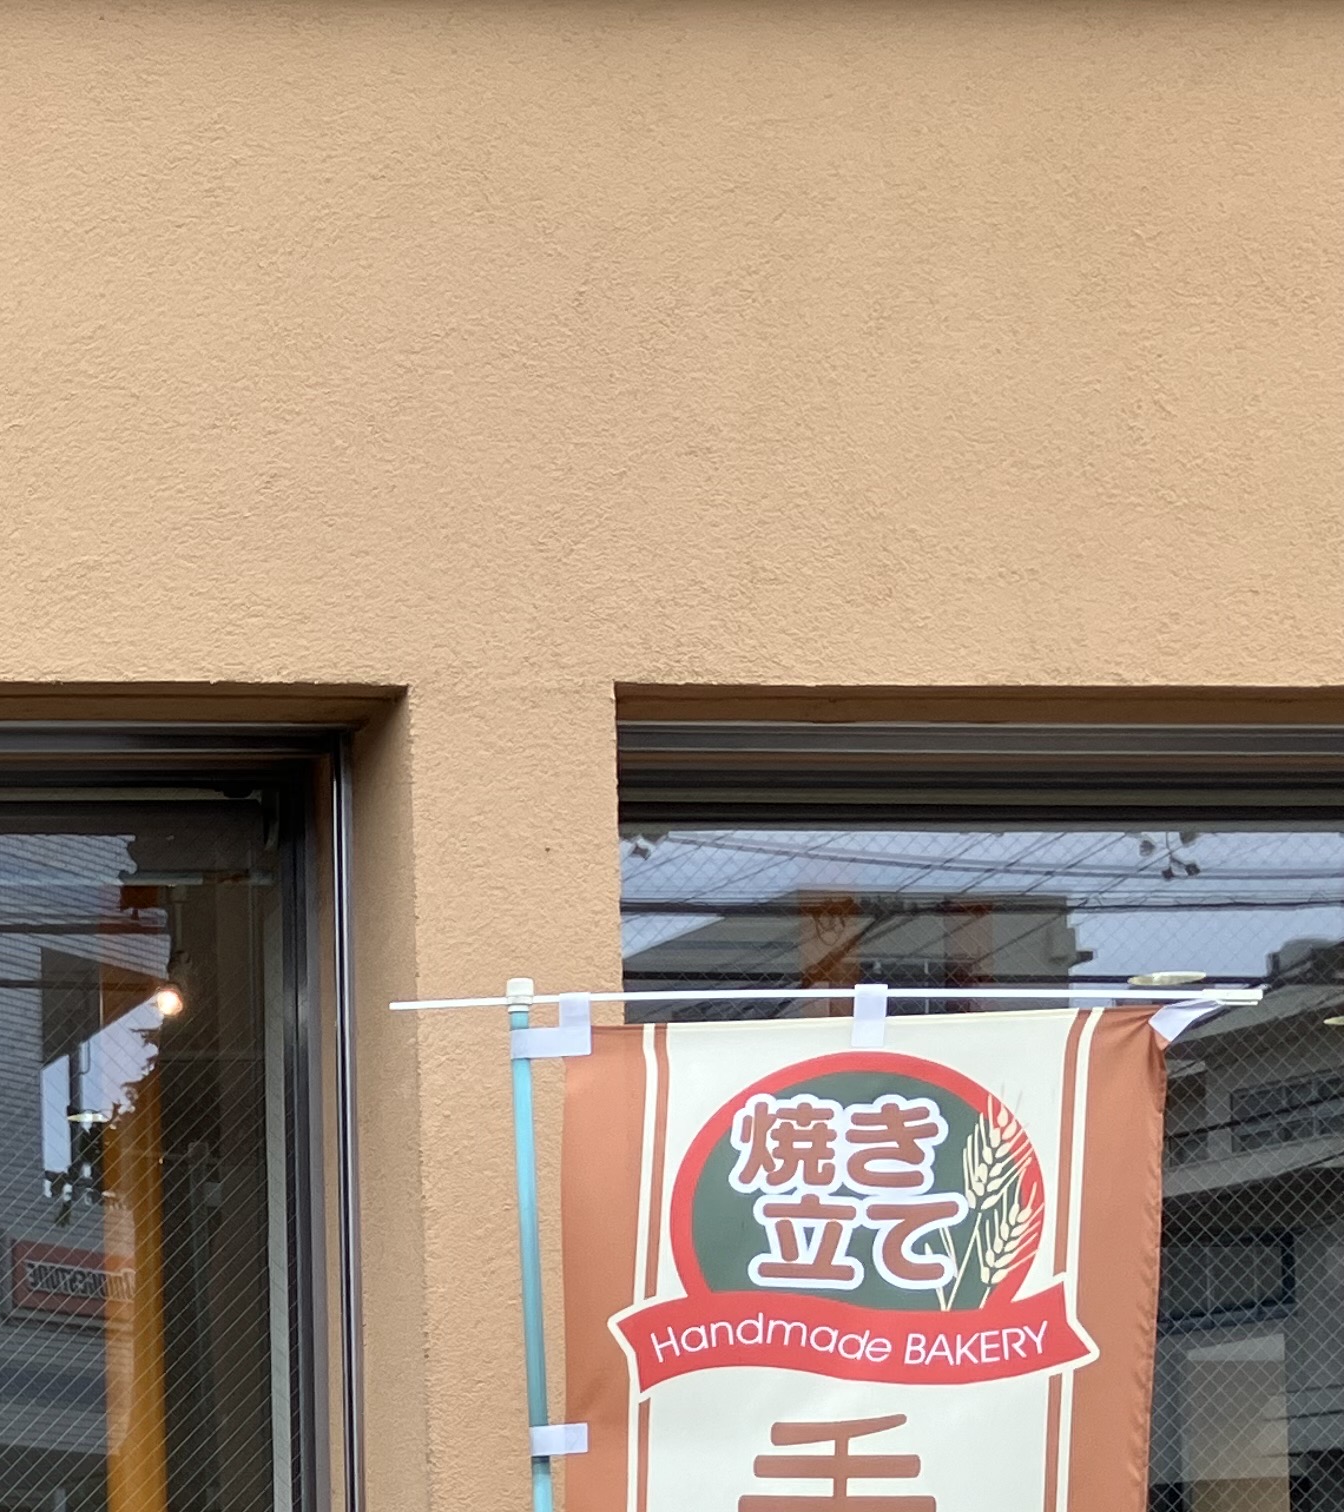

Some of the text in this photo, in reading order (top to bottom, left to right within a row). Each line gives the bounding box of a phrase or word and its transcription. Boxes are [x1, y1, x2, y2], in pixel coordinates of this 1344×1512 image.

[730, 1093, 948, 1195] 焼き
[748, 1193, 969, 1290] 立て
[650, 1313, 1049, 1366] Handmade BAKERY
